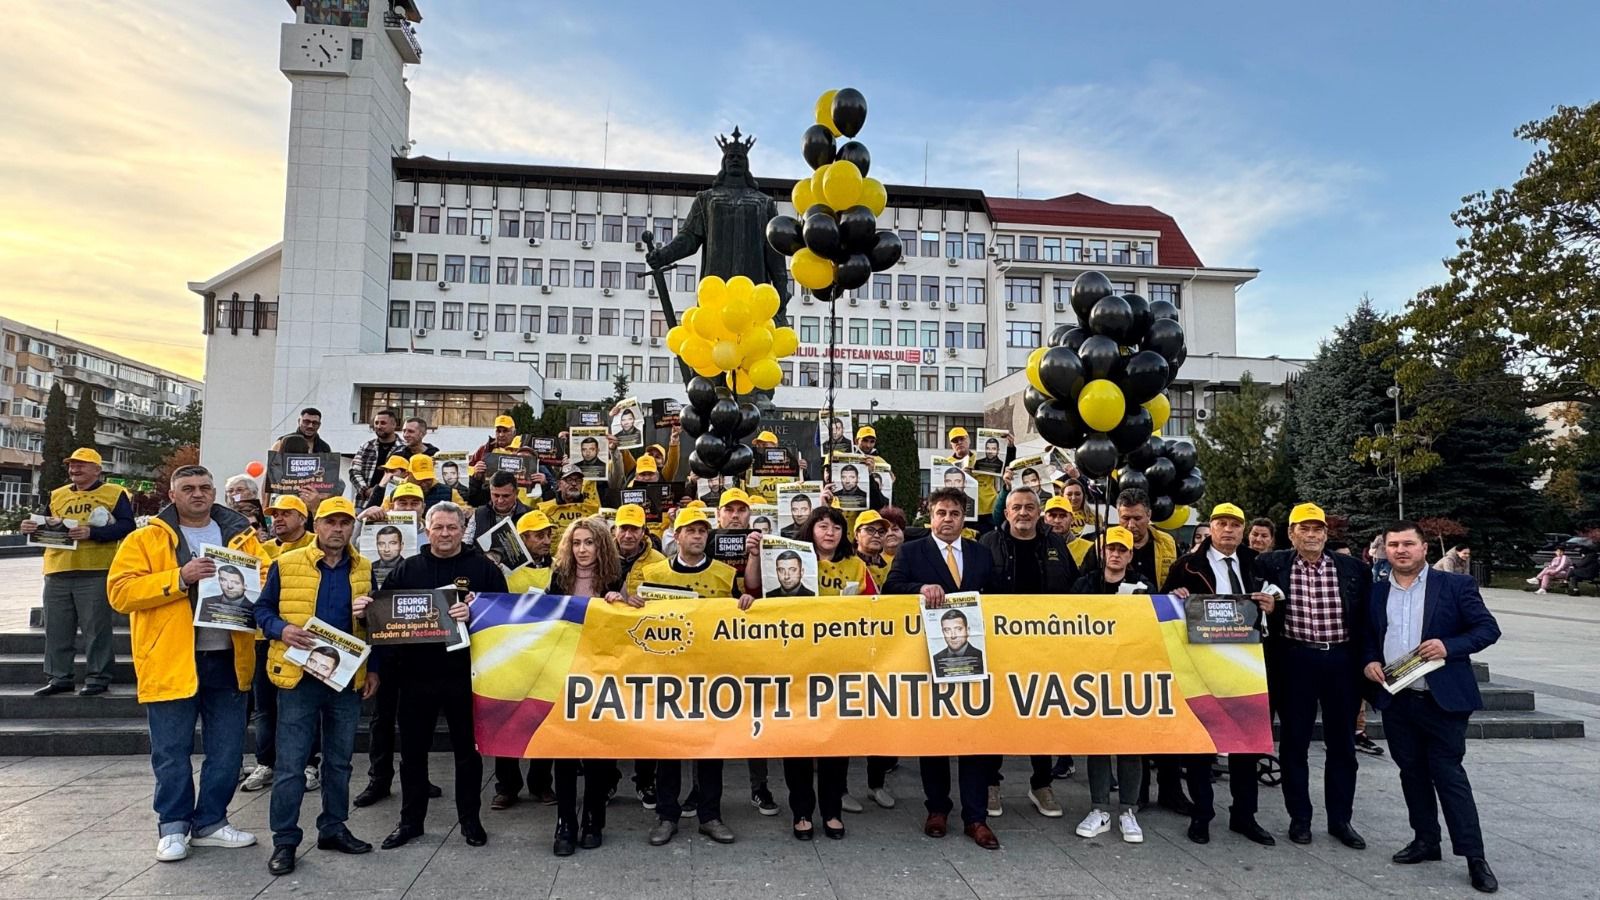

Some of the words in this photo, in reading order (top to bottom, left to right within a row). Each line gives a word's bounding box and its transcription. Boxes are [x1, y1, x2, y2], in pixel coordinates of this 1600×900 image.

[872, 350, 905, 360] VASLUI
[763, 484, 776, 492] AU
[65, 503, 92, 515] AUR
[719, 536, 744, 544] GEORGE
[205, 547, 230, 559] PLANUL
[231, 555, 257, 565] SIMION
[821, 575, 844, 590] UR
[397, 597, 428, 605] GEORGE
[1207, 602, 1233, 610] GEORGE
[397, 606, 428, 614] SIMION
[1208, 609, 1234, 617] SIMION
[644, 627, 682, 642] AUR
[713, 618, 804, 647] Alianța
[814, 617, 894, 643] pentru
[994, 614, 1116, 636] Românilor
[310, 625, 338, 641] PLANUL
[338, 637, 364, 652] SIMION
[567, 676, 791, 737] PATRIOȚI
[809, 674, 991, 717] PENTRU
[1009, 673, 1174, 716] VASLUI
